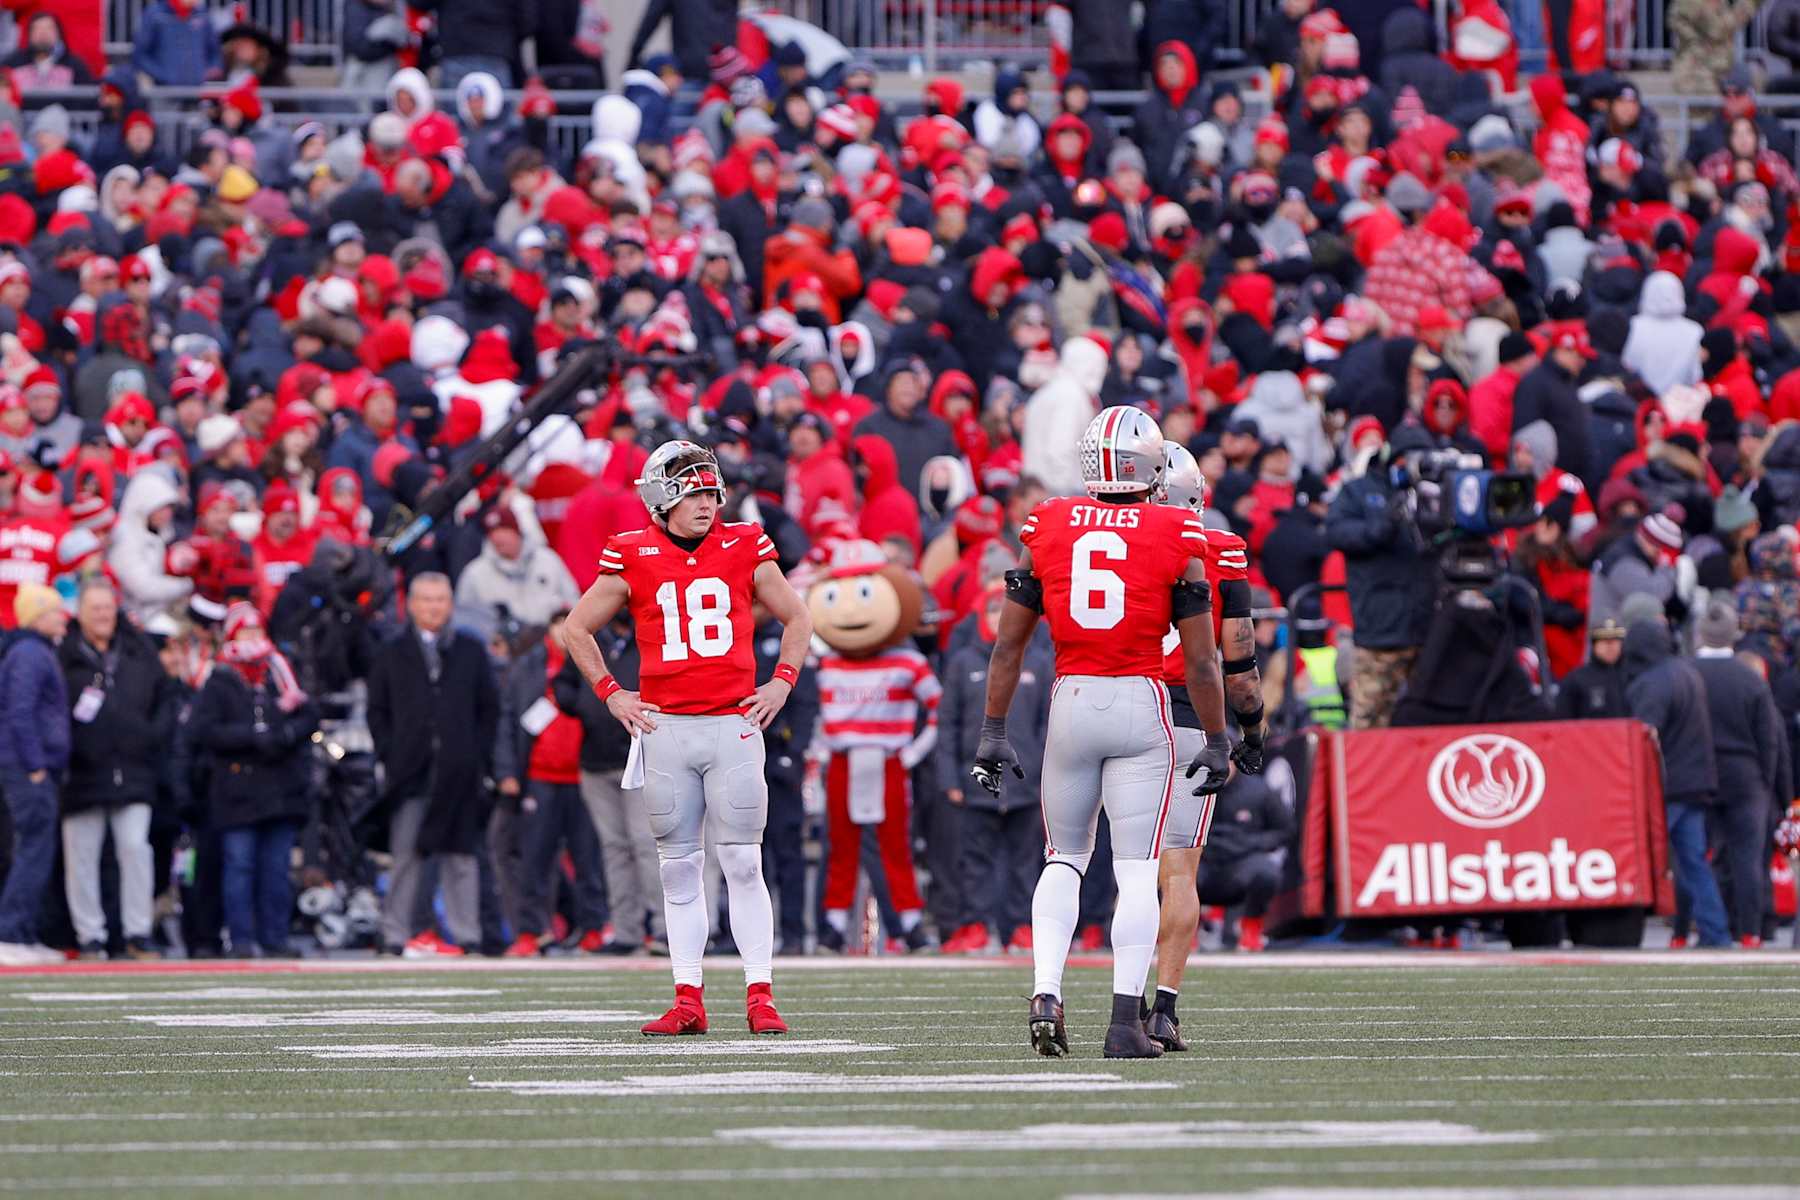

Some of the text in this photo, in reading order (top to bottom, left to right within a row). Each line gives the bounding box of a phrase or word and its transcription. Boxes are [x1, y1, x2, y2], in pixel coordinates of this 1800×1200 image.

[1123, 465, 1136, 473] 10
[1069, 505, 1141, 528] STYLES
[1069, 530, 1128, 630] 6
[655, 577, 734, 662] 18
[1356, 838, 1618, 907] Allstate
